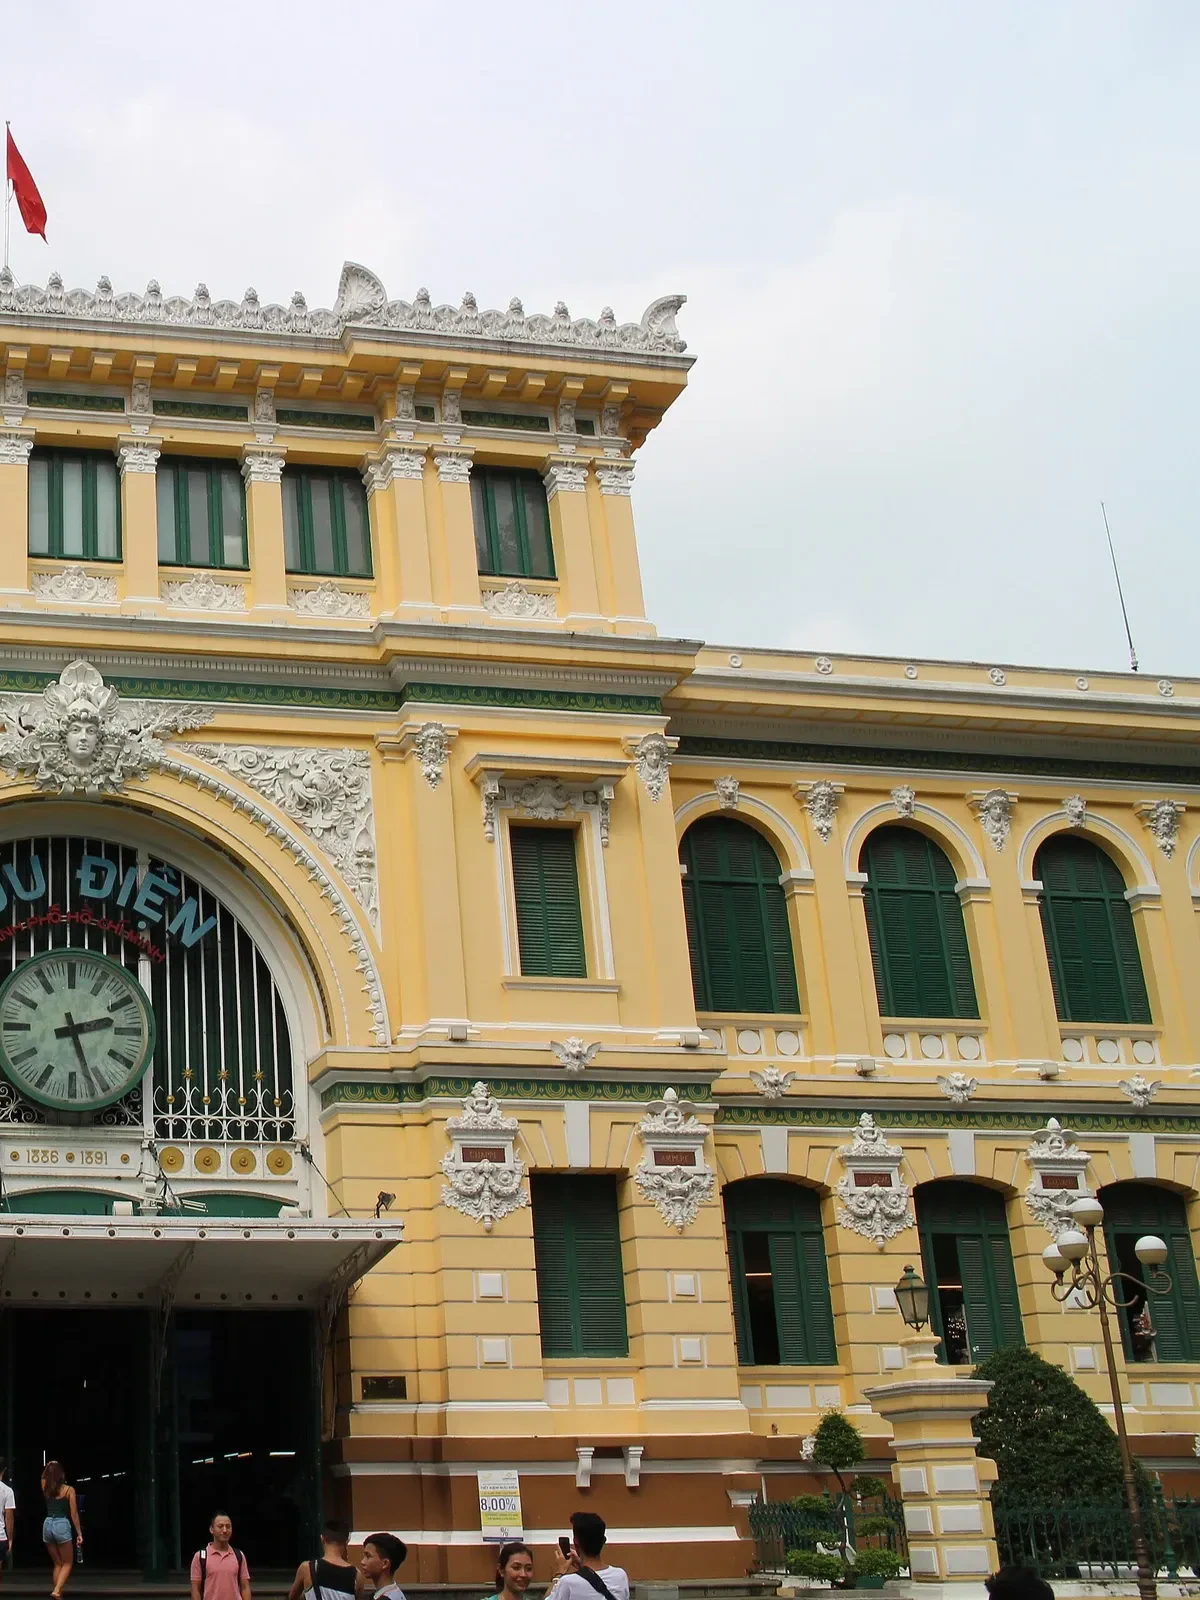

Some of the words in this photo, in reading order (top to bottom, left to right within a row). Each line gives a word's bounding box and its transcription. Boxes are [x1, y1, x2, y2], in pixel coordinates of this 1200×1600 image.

[75, 854, 218, 949] ĐIỆN
[66, 903, 92, 925] HỒ
[96, 918, 131, 937] CHÍ
[126, 929, 166, 964] MINH
[26, 1149, 59, 1164] 1886
[80, 1150, 108, 1165] 1891
[480, 1497, 516, 1511] 8,00%
